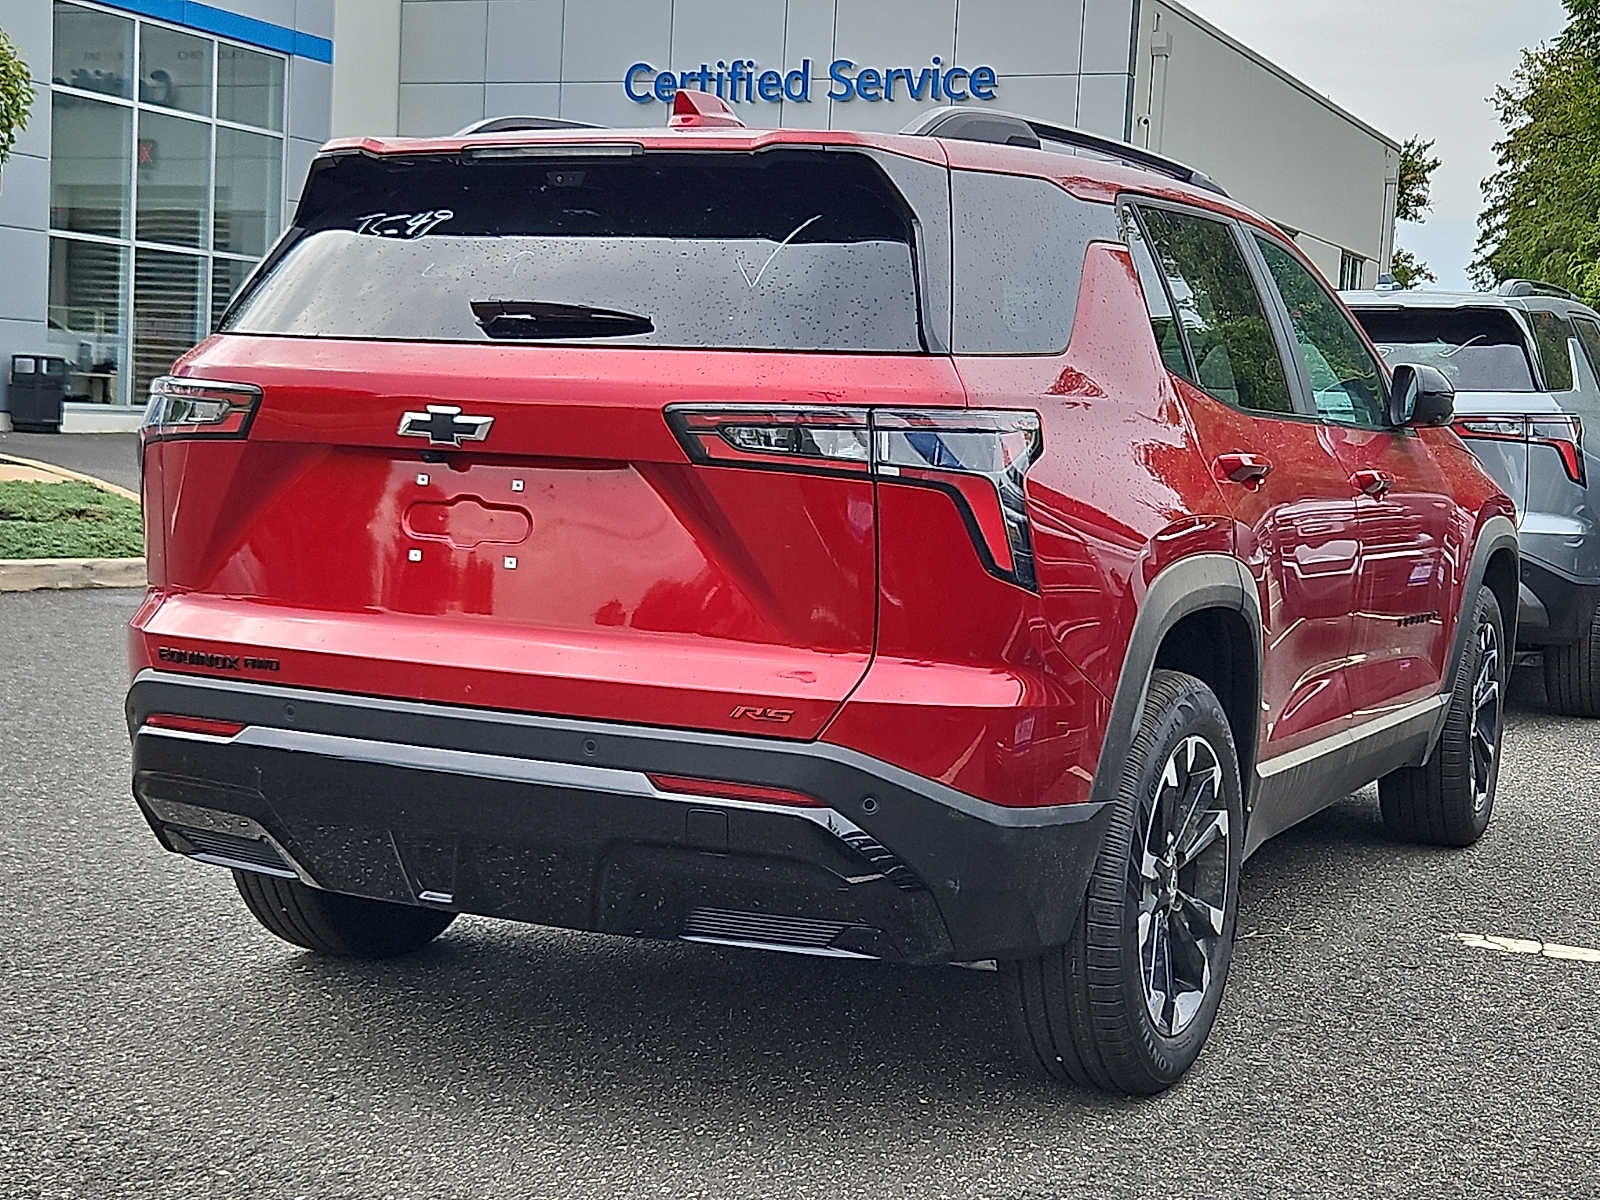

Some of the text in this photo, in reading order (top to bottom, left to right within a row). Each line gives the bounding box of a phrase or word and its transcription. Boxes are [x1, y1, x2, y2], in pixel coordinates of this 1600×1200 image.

[624, 56, 998, 103] Certified Service
[158, 646, 280, 672] EQUINOX AWD
[729, 704, 795, 723] RS
